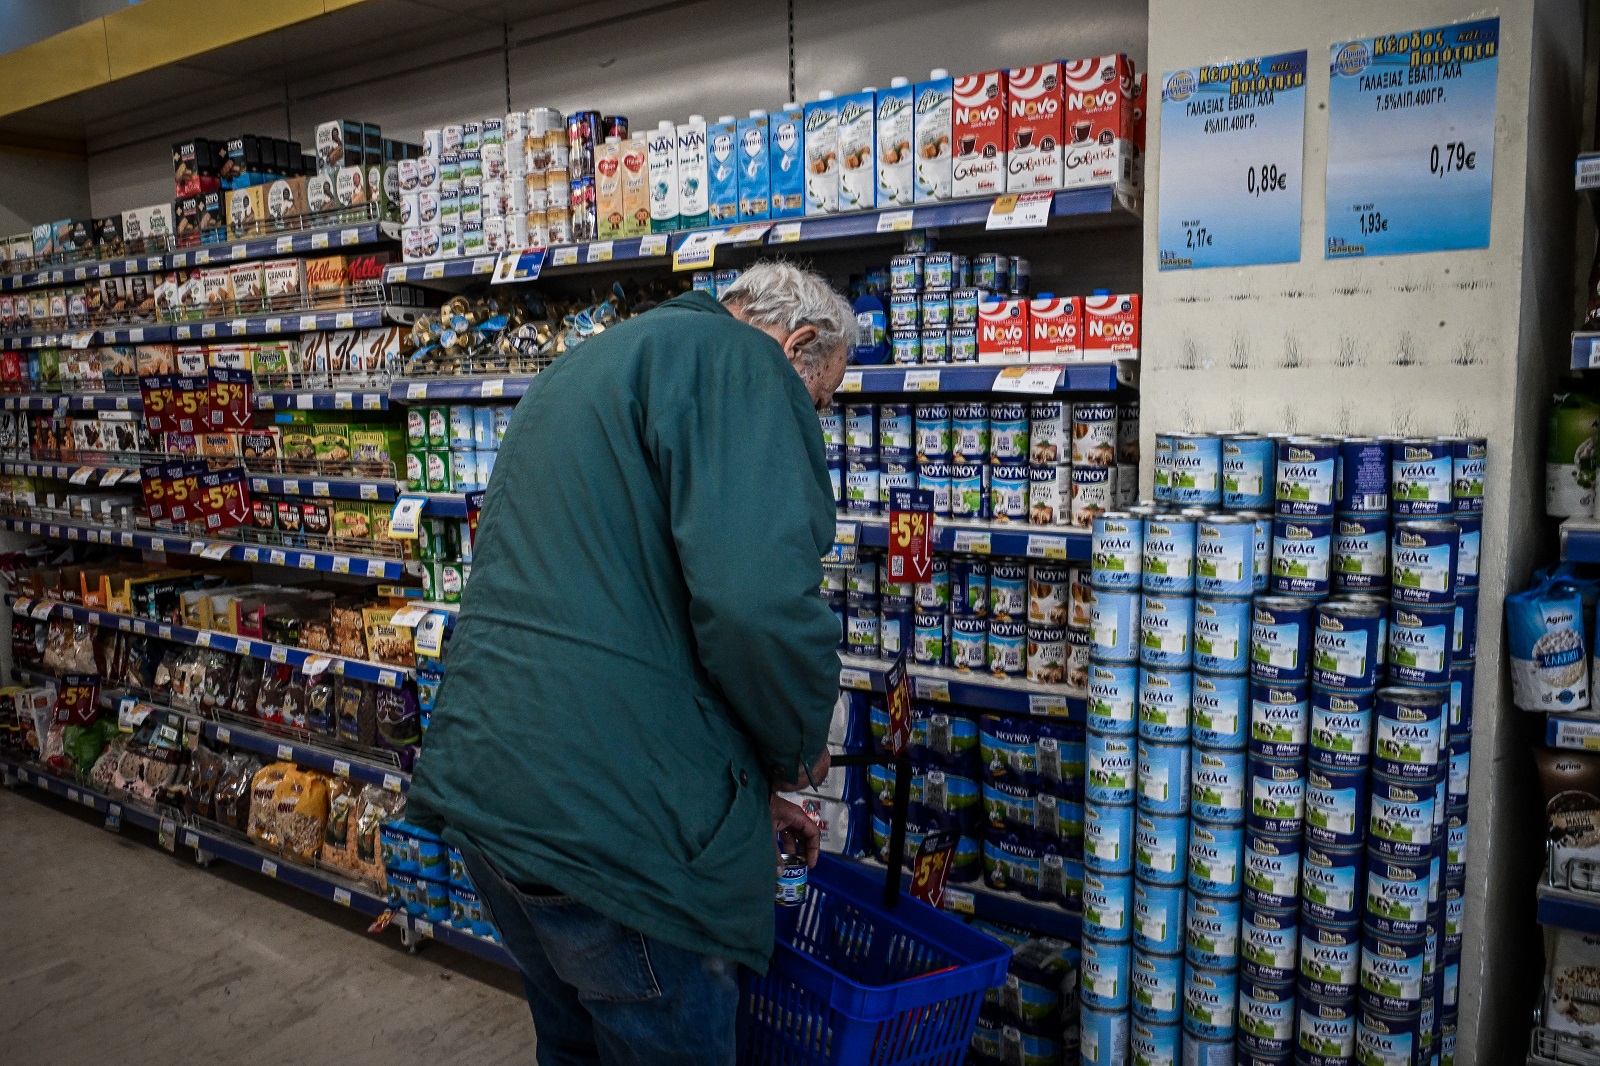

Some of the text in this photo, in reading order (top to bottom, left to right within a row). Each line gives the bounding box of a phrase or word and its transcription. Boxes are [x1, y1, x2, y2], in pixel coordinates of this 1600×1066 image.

[1374, 30, 1444, 56] Κέρδος
[1410, 41, 1496, 67] Ποιότητα
[1200, 63, 1260, 84] Κέρδος
[1359, 62, 1462, 92] ΓΑΛΑΞΙΑΣ ΕΒΑΠ.ΓΑΛΑ
[1230, 73, 1304, 95] Ποιότητα
[1187, 91, 1274, 117] ΓΑΛΑΞΙΑΣ ΕΒΑΠ.ΓΑΛΑ
[1430, 141, 1476, 179] 0,79€
[1248, 163, 1287, 197] 0,89€
[1359, 212, 1388, 237] 1,93€
[1187, 228, 1212, 251] 2,17€
[210, 383, 243, 406] -5%
[1174, 456, 1201, 468] γάλα
[1284, 465, 1318, 478] γάλα
[1401, 464, 1436, 477] γάλα
[202, 484, 238, 509] -5%
[891, 512, 925, 547] -5%
[1100, 538, 1131, 549] γάλα
[1146, 539, 1174, 552] γάλα
[1281, 543, 1315, 555] γάλα
[1336, 540, 1369, 552] γάλα
[1397, 552, 1430, 564] γάλα
[1546, 614, 1573, 625] Agrino
[1316, 632, 1346, 648] γάλα
[1393, 629, 1425, 643] γάλα
[1090, 684, 1118, 696] γάλα
[1143, 691, 1173, 703] γάλα
[1265, 708, 1299, 719] γάλα
[1324, 717, 1360, 729] γάλα
[1391, 725, 1429, 738] γάλα
[1101, 758, 1131, 770] γάλα
[1197, 771, 1228, 784] γάλα
[1267, 786, 1301, 797] γάλα
[1384, 805, 1421, 817] γάλα
[915, 851, 946, 888] -5%
[1250, 857, 1282, 871] γάλα
[1381, 884, 1418, 897] γάλα
[1192, 917, 1222, 931] γάλα
[1250, 931, 1283, 945] γάλα
[1313, 948, 1348, 961] γάλα
[1372, 960, 1409, 975] γάλα
[1189, 989, 1219, 1003] γάλα
[1248, 1003, 1282, 1017] γάλα
[1313, 1023, 1348, 1035] γάλα
[1360, 1032, 1393, 1049] γάλα
